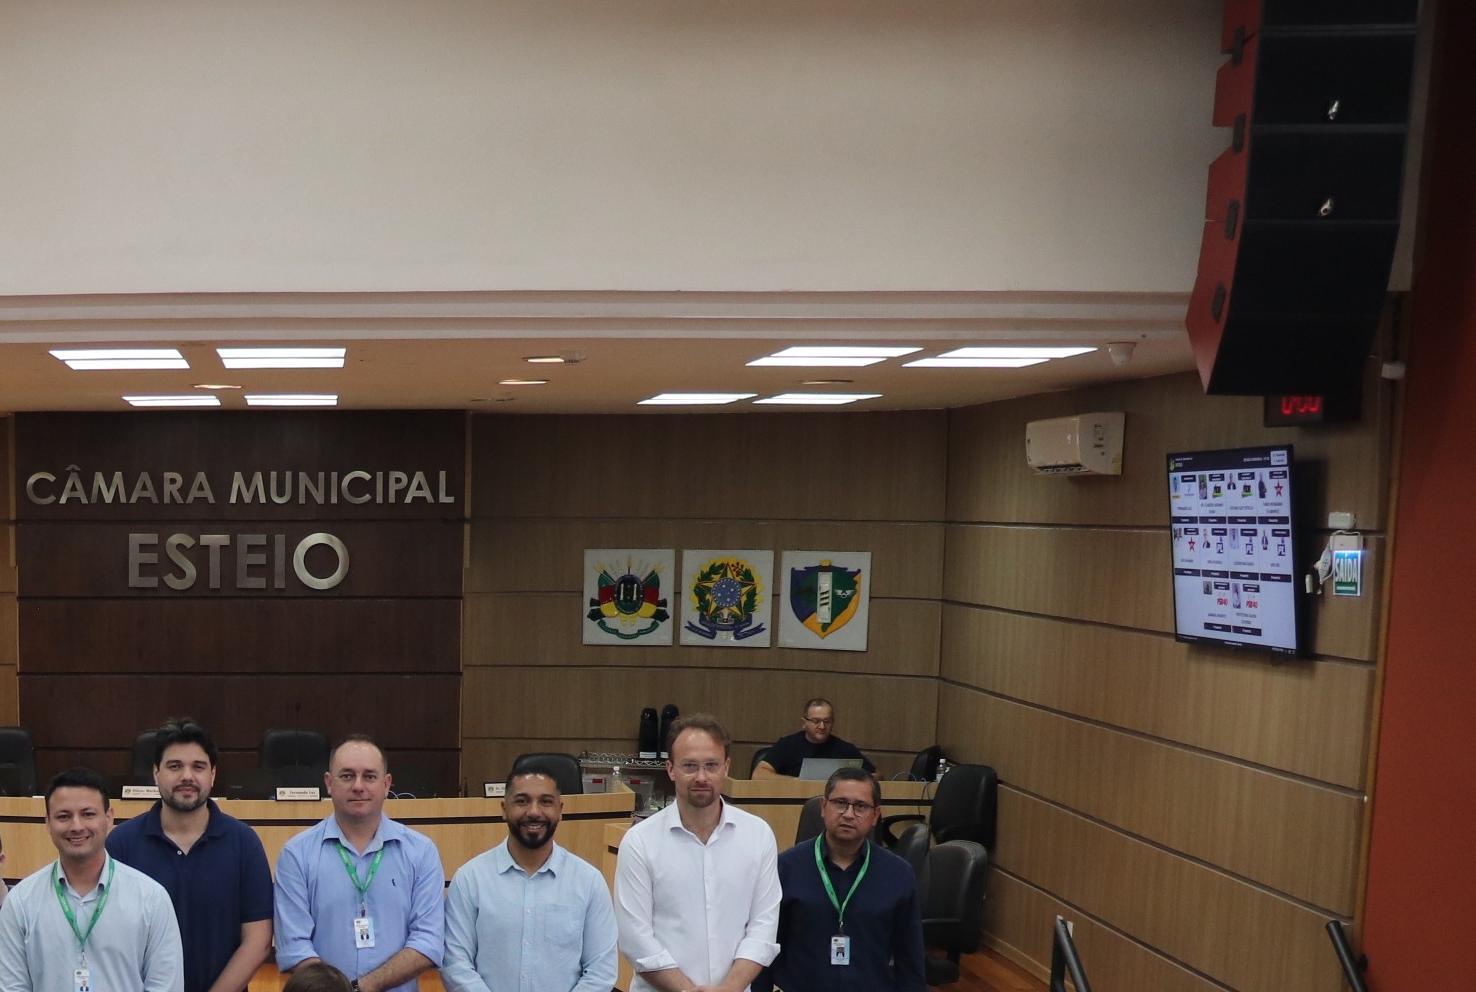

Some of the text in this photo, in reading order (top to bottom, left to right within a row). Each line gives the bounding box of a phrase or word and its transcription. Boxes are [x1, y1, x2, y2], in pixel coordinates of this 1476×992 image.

[26, 464, 455, 505] CÂMARA MUNICIPAL
[128, 532, 350, 591] ESTEIO
[1335, 552, 1358, 583] SAÍDA
